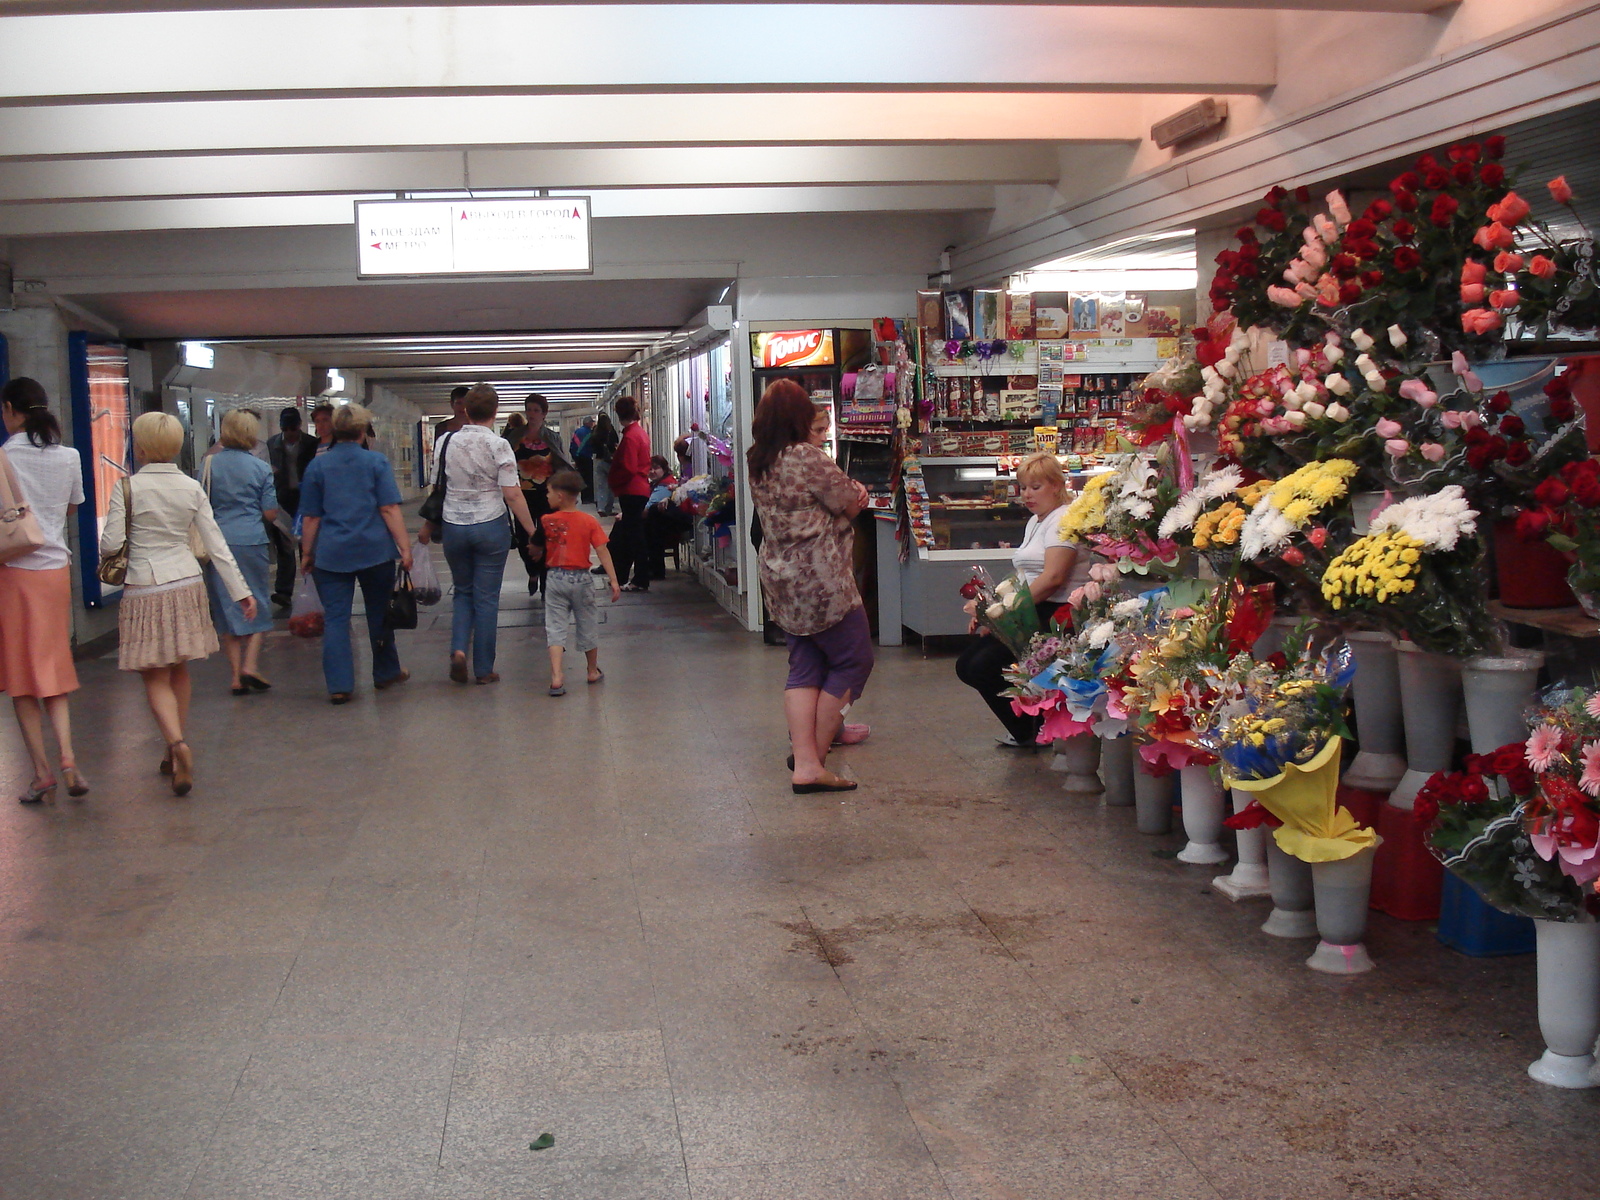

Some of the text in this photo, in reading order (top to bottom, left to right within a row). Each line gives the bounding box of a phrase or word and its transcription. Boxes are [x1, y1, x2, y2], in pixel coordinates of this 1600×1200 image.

[530, 208, 571, 220] ГОРОД
[381, 226, 441, 237] ПОЕЗДАМ
[385, 241, 427, 251] МЕТРО
[850, 414, 886, 422] COSMOPOLITAN
